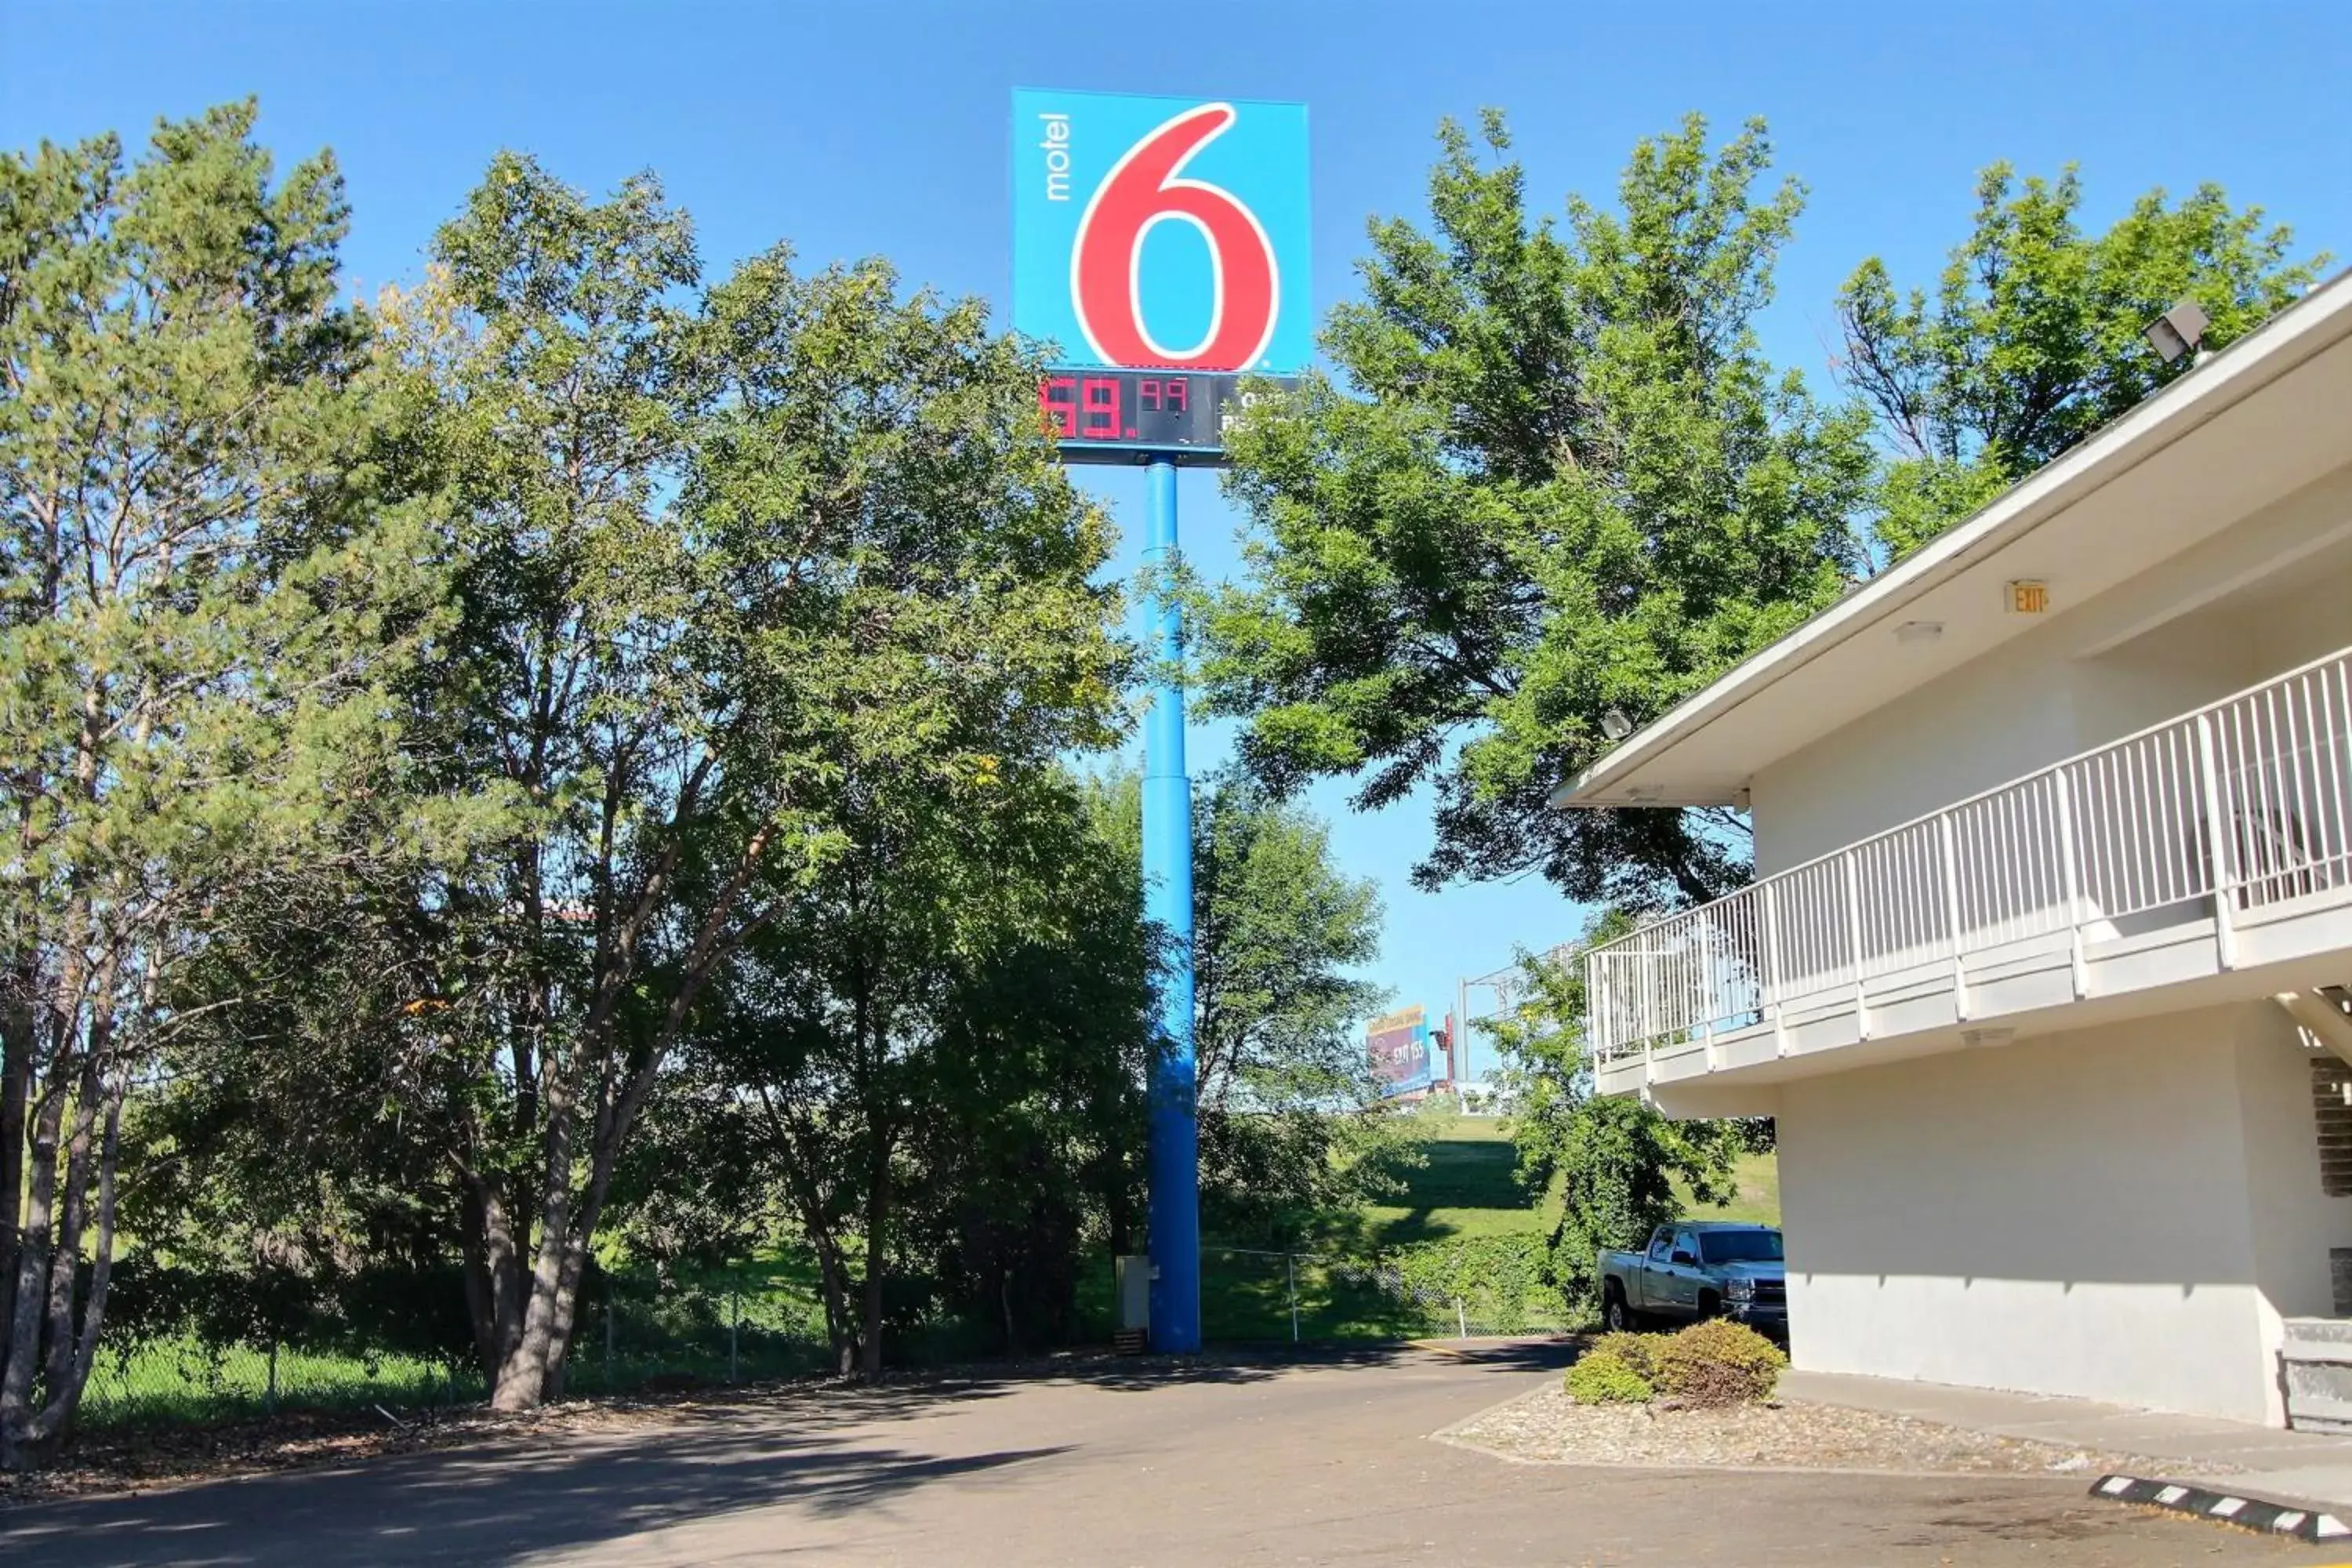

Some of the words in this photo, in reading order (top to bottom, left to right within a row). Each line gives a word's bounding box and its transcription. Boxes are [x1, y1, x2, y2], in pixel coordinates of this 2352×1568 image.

[1038, 114, 1070, 201] motel
[1069, 102, 1280, 371] 6
[2015, 587, 2043, 613] EXIT
